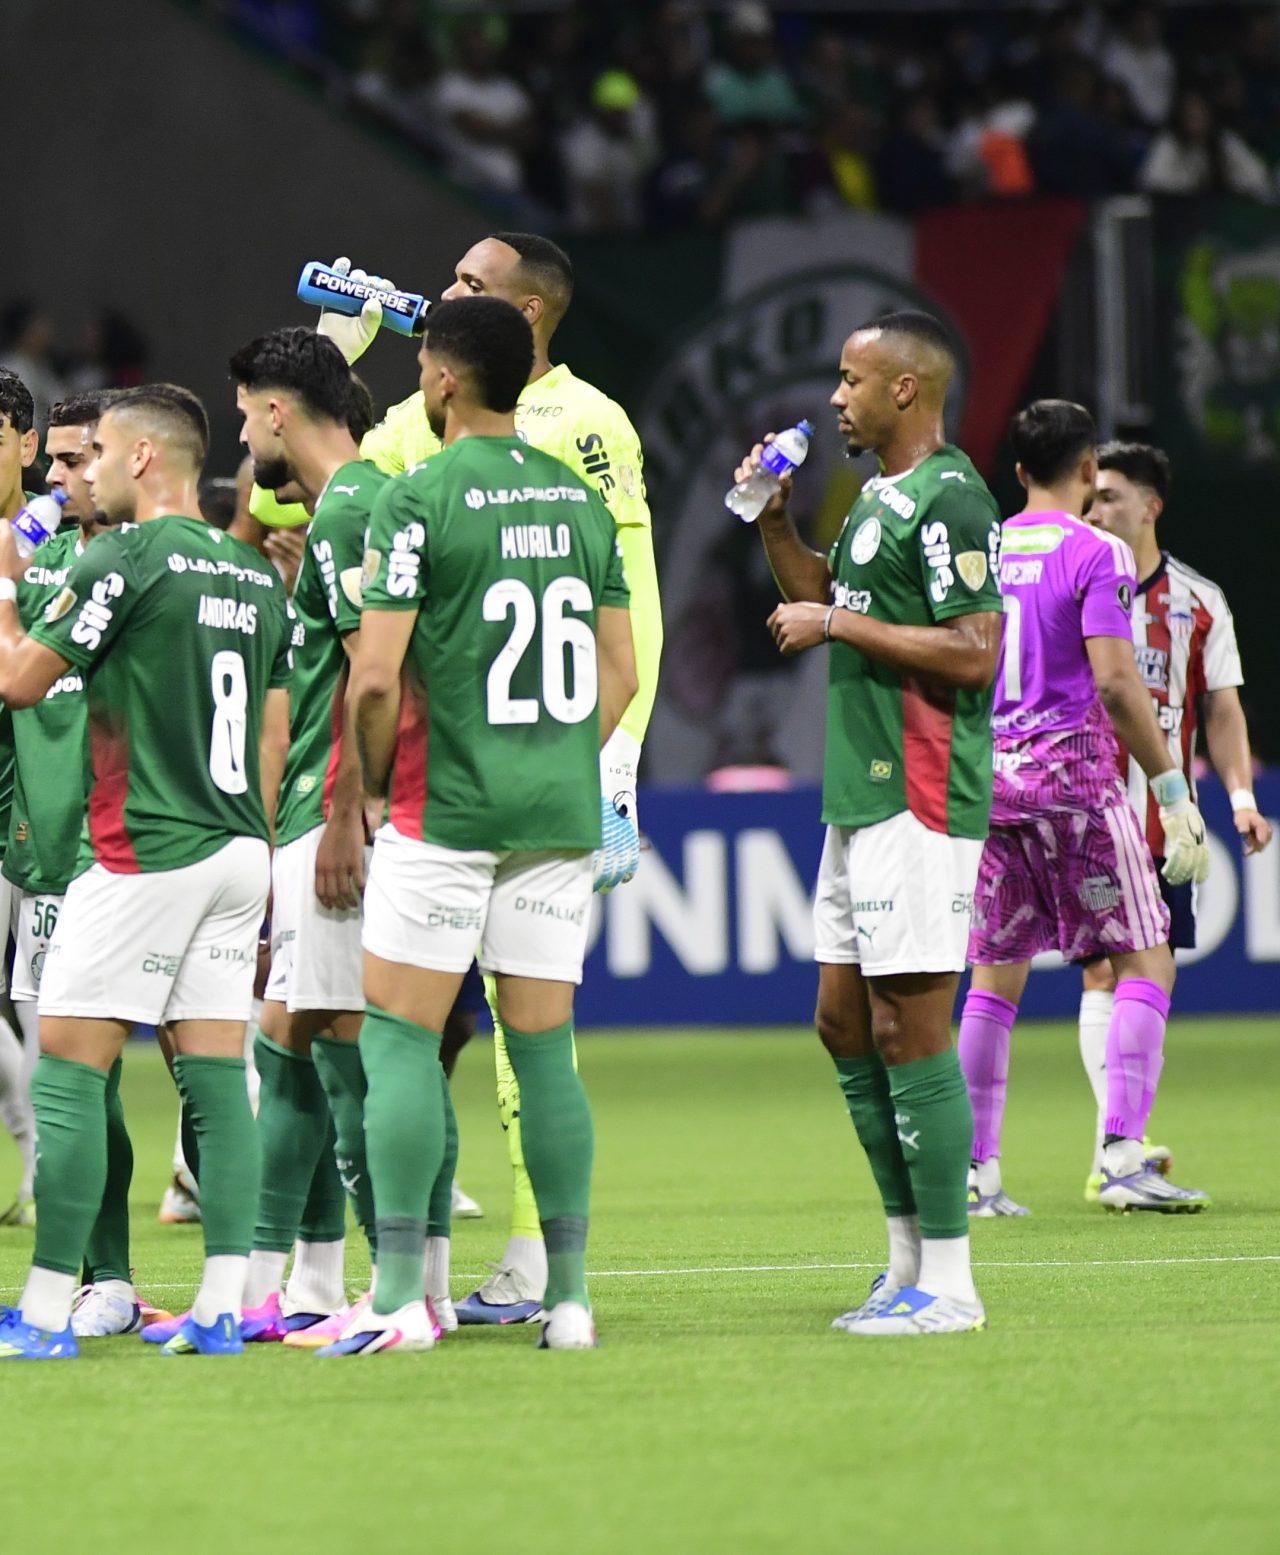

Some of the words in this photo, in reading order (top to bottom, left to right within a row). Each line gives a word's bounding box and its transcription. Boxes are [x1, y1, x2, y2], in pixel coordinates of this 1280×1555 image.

[316, 272, 410, 313] POWERADE
[501, 524, 570, 559] MURILO
[482, 576, 597, 725] 26
[209, 651, 248, 794] 8
[32, 901, 57, 938] 56
